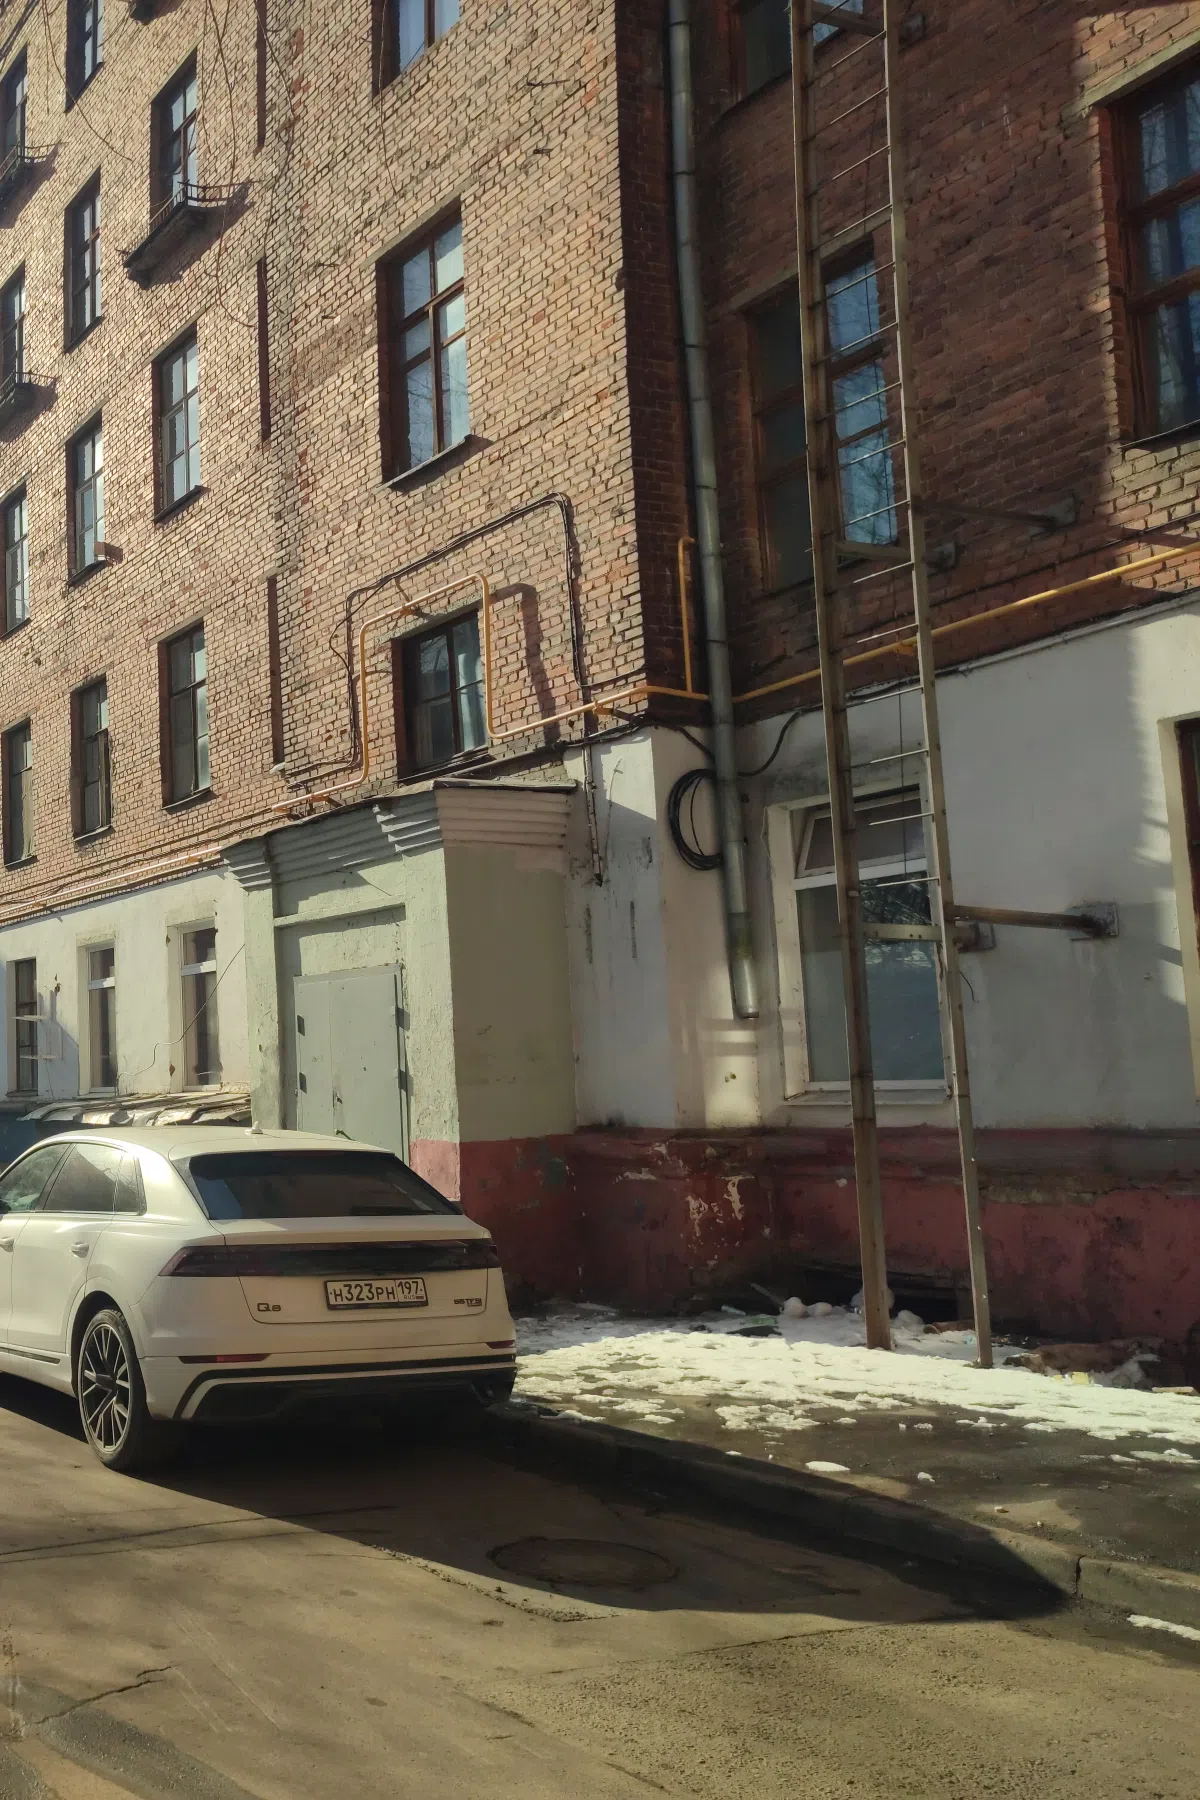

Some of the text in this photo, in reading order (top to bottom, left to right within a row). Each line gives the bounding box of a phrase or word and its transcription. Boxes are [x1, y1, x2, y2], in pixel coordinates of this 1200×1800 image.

[333, 1281, 419, 1302] Н323РН 197
[257, 1303, 281, 1312] Q8
